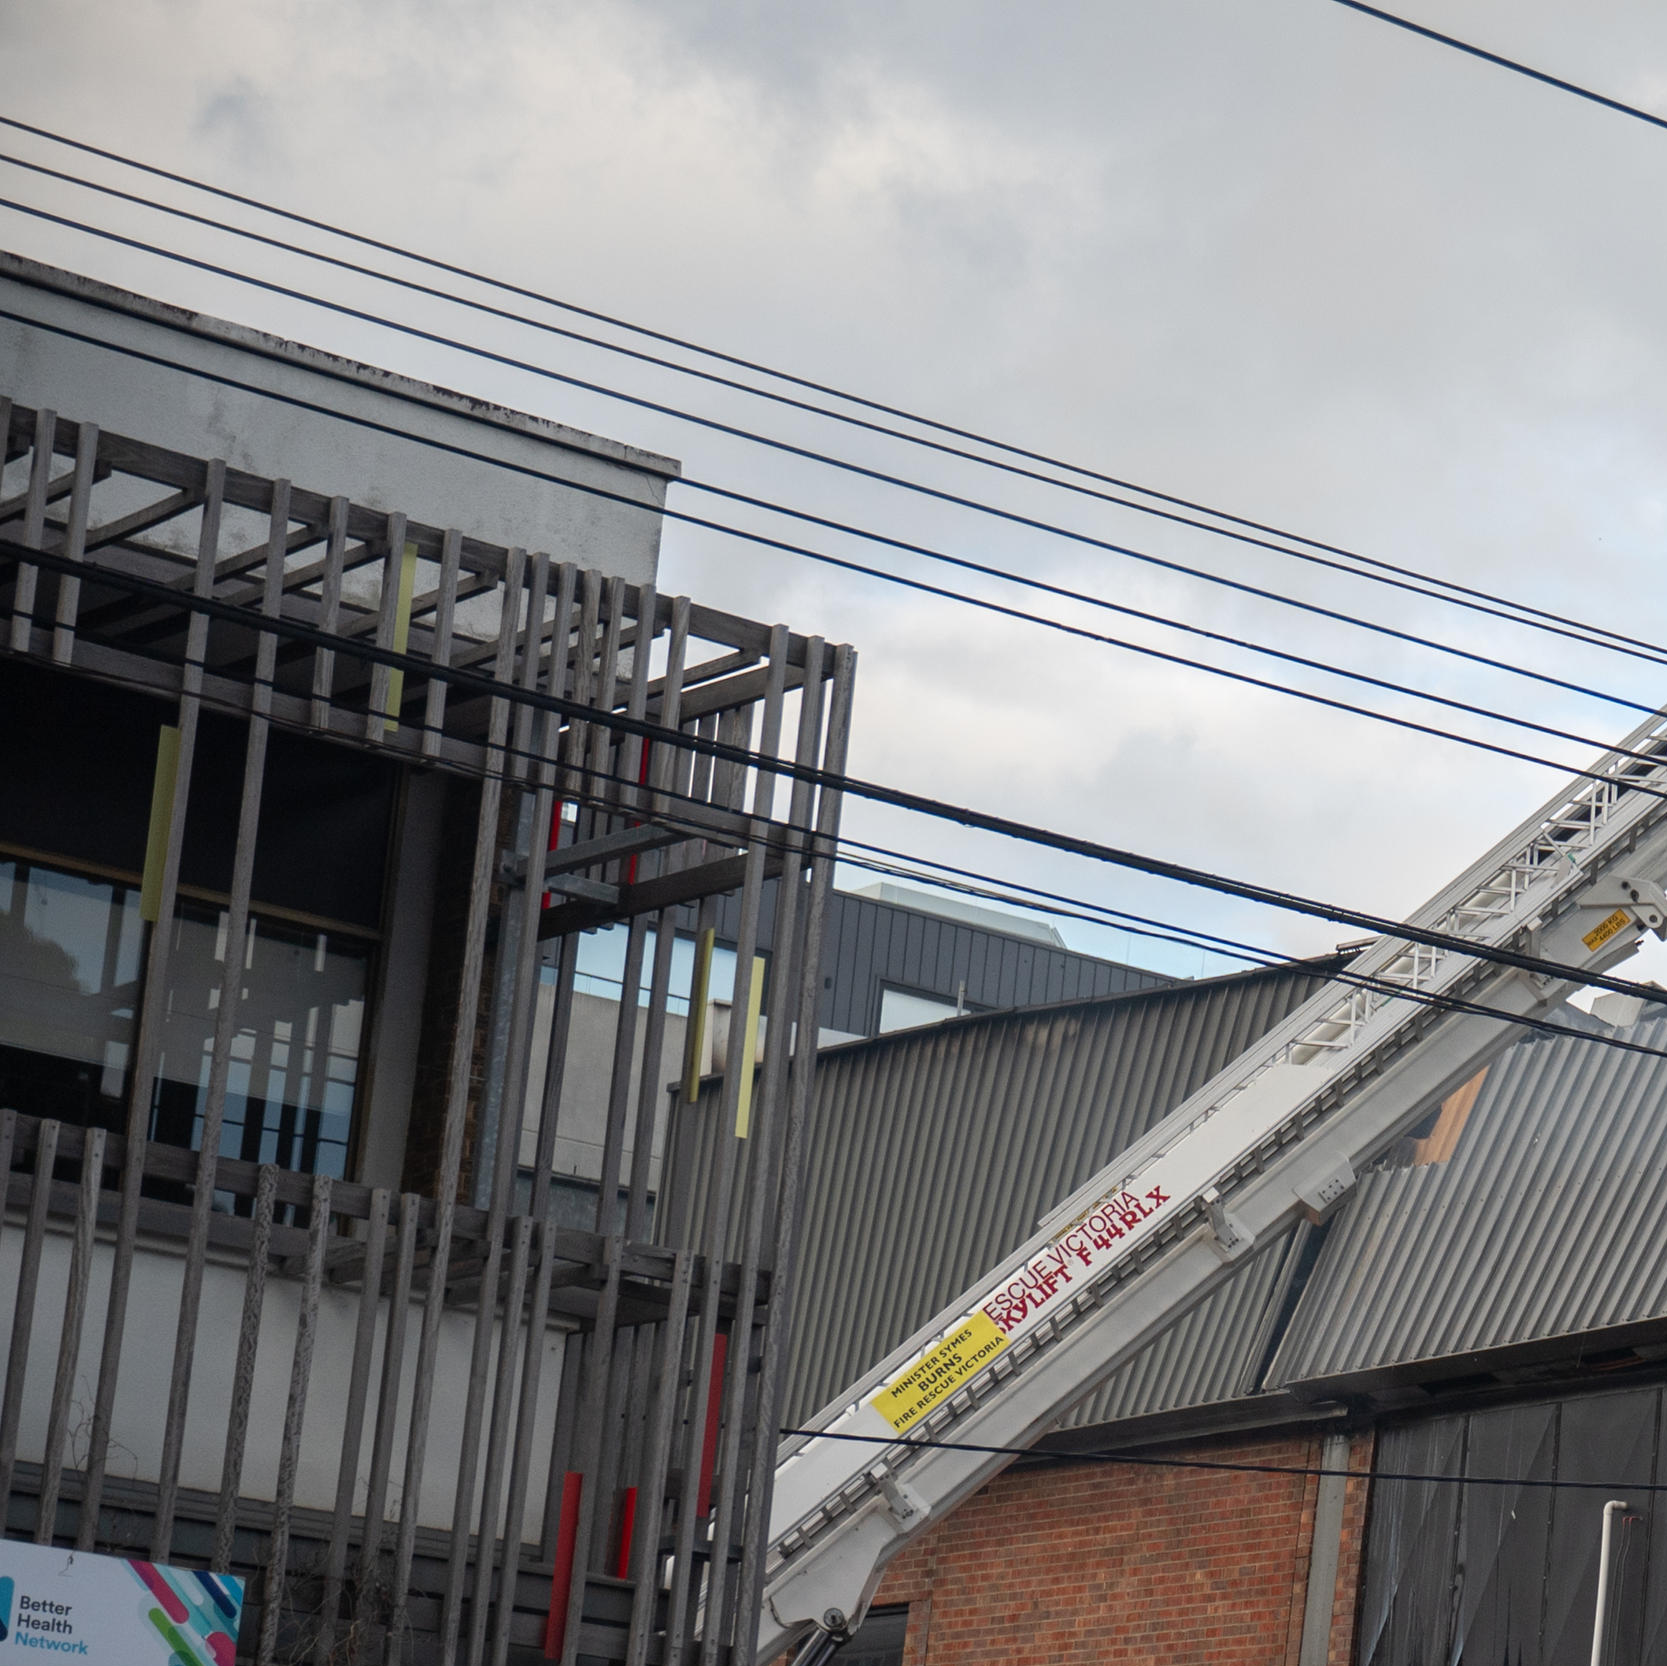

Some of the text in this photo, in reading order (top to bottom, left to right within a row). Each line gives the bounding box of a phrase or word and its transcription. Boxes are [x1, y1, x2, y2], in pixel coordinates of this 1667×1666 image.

[982, 1259, 1055, 1321] ESCUE
[1046, 1190, 1141, 1264] VICTORIA
[1076, 1246, 1093, 1267] F
[891, 1328, 973, 1398] MINISTER SYMES
[919, 1352, 963, 1392] BURNS
[894, 1335, 1005, 1429] FIRE RESCUE VICTORIA
[20, 1595, 72, 1616] Better
[17, 1613, 73, 1635] Health
[14, 1631, 89, 1655] Network
